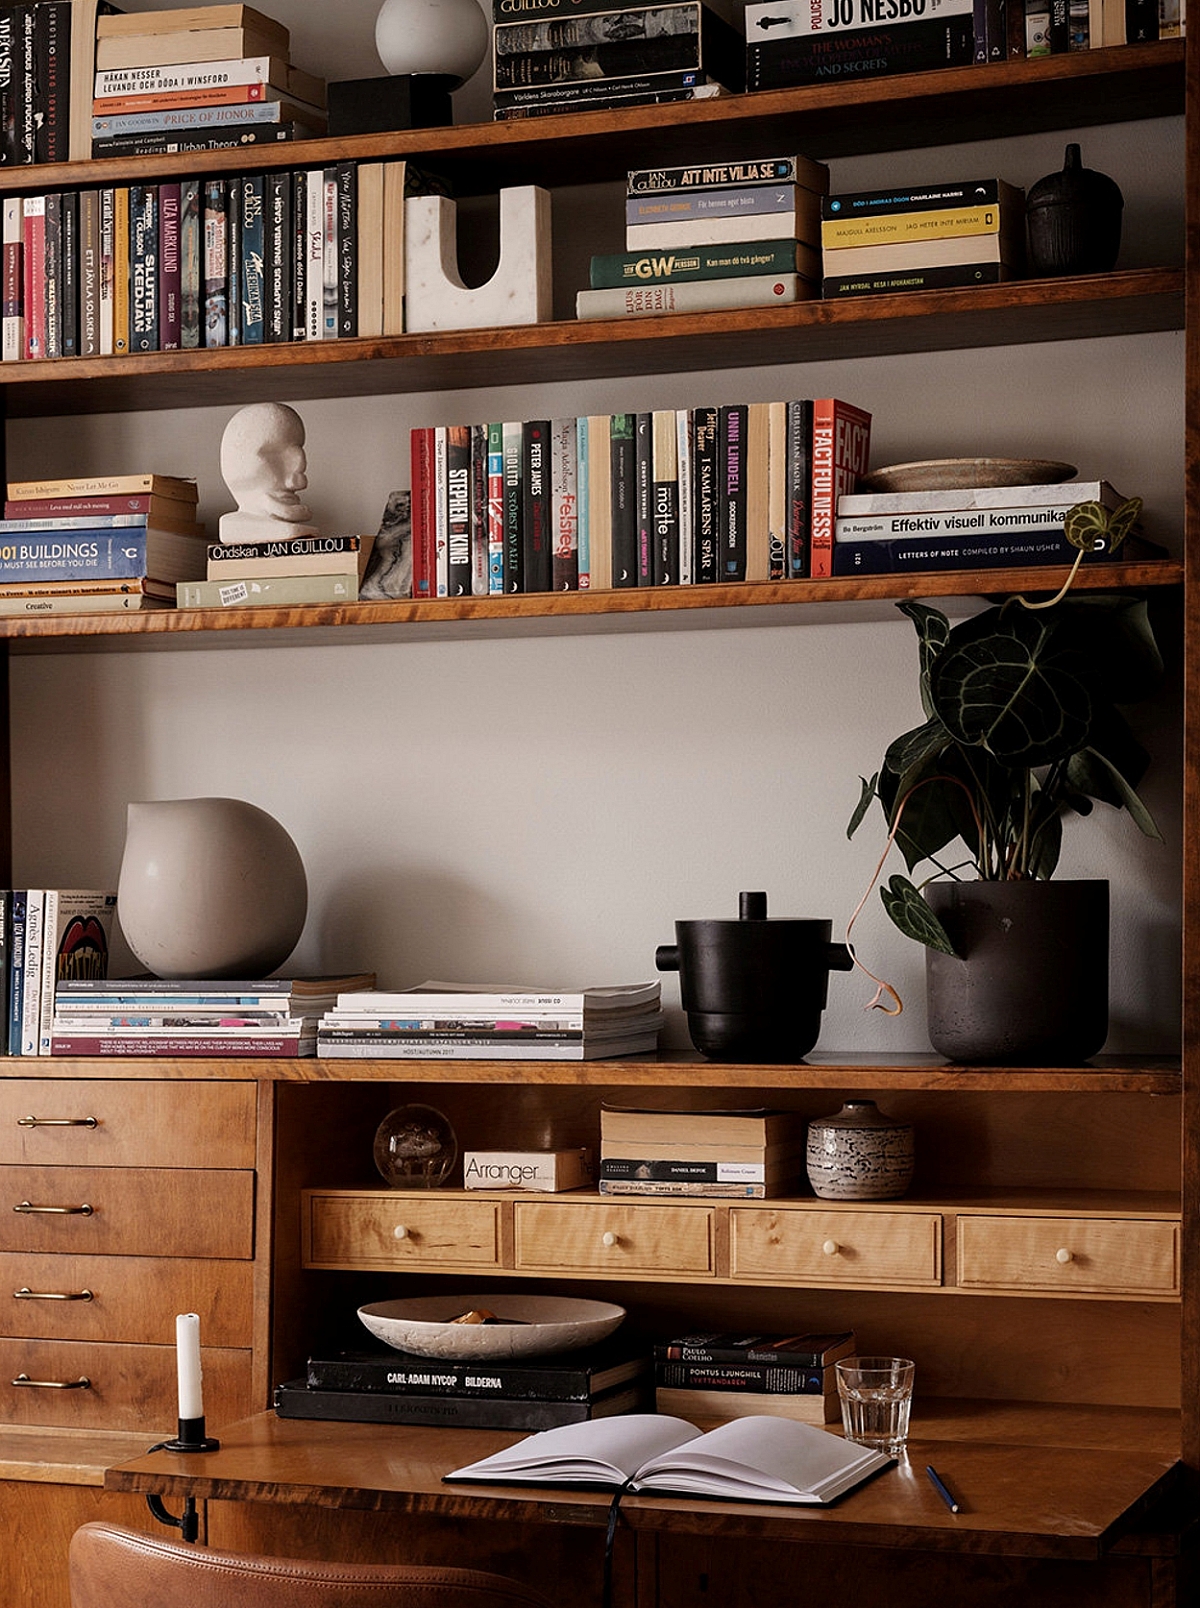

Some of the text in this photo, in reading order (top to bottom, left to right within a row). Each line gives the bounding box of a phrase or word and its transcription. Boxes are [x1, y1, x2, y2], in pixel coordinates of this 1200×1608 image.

[811, 0, 822, 30] POLICE
[828, 0, 853, 27] JO
[104, 69, 161, 82] HÅKAN NESSER
[815, 57, 889, 77] AND SECRETS
[24, 13, 33, 151] JENS LAPIDUS ALDRIG FUCKA UPP
[103, 82, 137, 93] LEVANDE
[139, 80, 156, 90] OCH
[158, 77, 179, 88] DÖDA
[187, 73, 229, 85] WINSFORD
[162, 108, 255, 125] PRICE OF HONOR
[180, 138, 239, 152] Urban Theory
[637, 178, 677, 190] GUILLOU
[649, 172, 666, 181] JAN
[681, 163, 775, 185] ATT INTE VILJA SE
[145, 193, 153, 230] FREDRIK
[244, 183, 254, 229] GUILLOU
[253, 195, 262, 216] JAN
[136, 222, 144, 256] OLSSON
[163, 198, 178, 273] LIZA MARKLUND
[865, 225, 897, 234] AXELSSON
[920, 220, 938, 229] HETER
[940, 219, 954, 227] INTE
[85, 249, 94, 268] ETT
[309, 231, 321, 262] Skadad
[273, 197, 282, 337] JENS LAPIDUS SNABBA CASH
[296, 230, 304, 304] Levande död Dallas
[635, 255, 676, 279] GW
[706, 253, 775, 267] Kan man dö två gånger?
[85, 268, 95, 299] JÄVLA
[145, 254, 155, 319] SLUTET
[245, 259, 262, 322] AMERIKANSKA
[839, 283, 850, 292] JAN
[873, 280, 886, 289] RESA
[890, 277, 925, 287] AFGHANISTAN
[135, 263, 145, 332] KEDJAN
[626, 290, 634, 313] LJUS
[634, 290, 643, 311] FÖR
[645, 291, 653, 310] DIN
[655, 289, 663, 310] DAG
[85, 299, 94, 340] SOLSKEN
[697, 425, 707, 452] Deaver
[706, 412, 717, 440] Jeffery
[793, 404, 801, 459] CHRISTIAN
[530, 443, 542, 469] PETER
[67, 482, 84, 492] Never
[448, 468, 469, 523] STEPHEN
[530, 469, 542, 496] JAMES
[813, 428, 832, 538] FACTFULNESS
[506, 447, 519, 572] GIOLITO STÖRST AV ALLT
[555, 453, 578, 558] Adolfsson Felsteg
[654, 487, 675, 535] motte
[701, 465, 711, 535] SAMLARENS
[728, 500, 738, 549] SOCKERDÖDEN
[789, 500, 805, 536] Darling
[852, 524, 884, 533] Bergström
[891, 518, 940, 533] Effektiv
[944, 514, 985, 529] visuell
[989, 509, 1069, 527] kommunika
[0, 545, 17, 561] 01
[20, 542, 99, 559] BUILDINGS
[212, 538, 344, 559] Ondskan JAN GUILLOU
[449, 533, 469, 564] KING
[701, 539, 714, 570] SPÅR
[854, 552, 862, 565] 021
[898, 542, 1061, 560] LETTERS OF NOTE COMPILED BY SHAUN USHER
[3, 558, 98, 570] MUST SEE BEFORE YOU DIE
[25, 602, 53, 610] Creative
[14, 923, 24, 936] LIZA
[26, 904, 40, 978] Agnès Ledig
[13, 936, 23, 968] MARKLUND
[465, 1157, 540, 1186] Arranger
[682, 1347, 706, 1356] PAULO
[682, 1354, 713, 1362] COELHO
[431, 1373, 458, 1387] NYCOP
[464, 1375, 503, 1389] BILDERNA
[689, 1368, 720, 1378] PONTUS
[720, 1368, 762, 1380] LJUNGHILL
